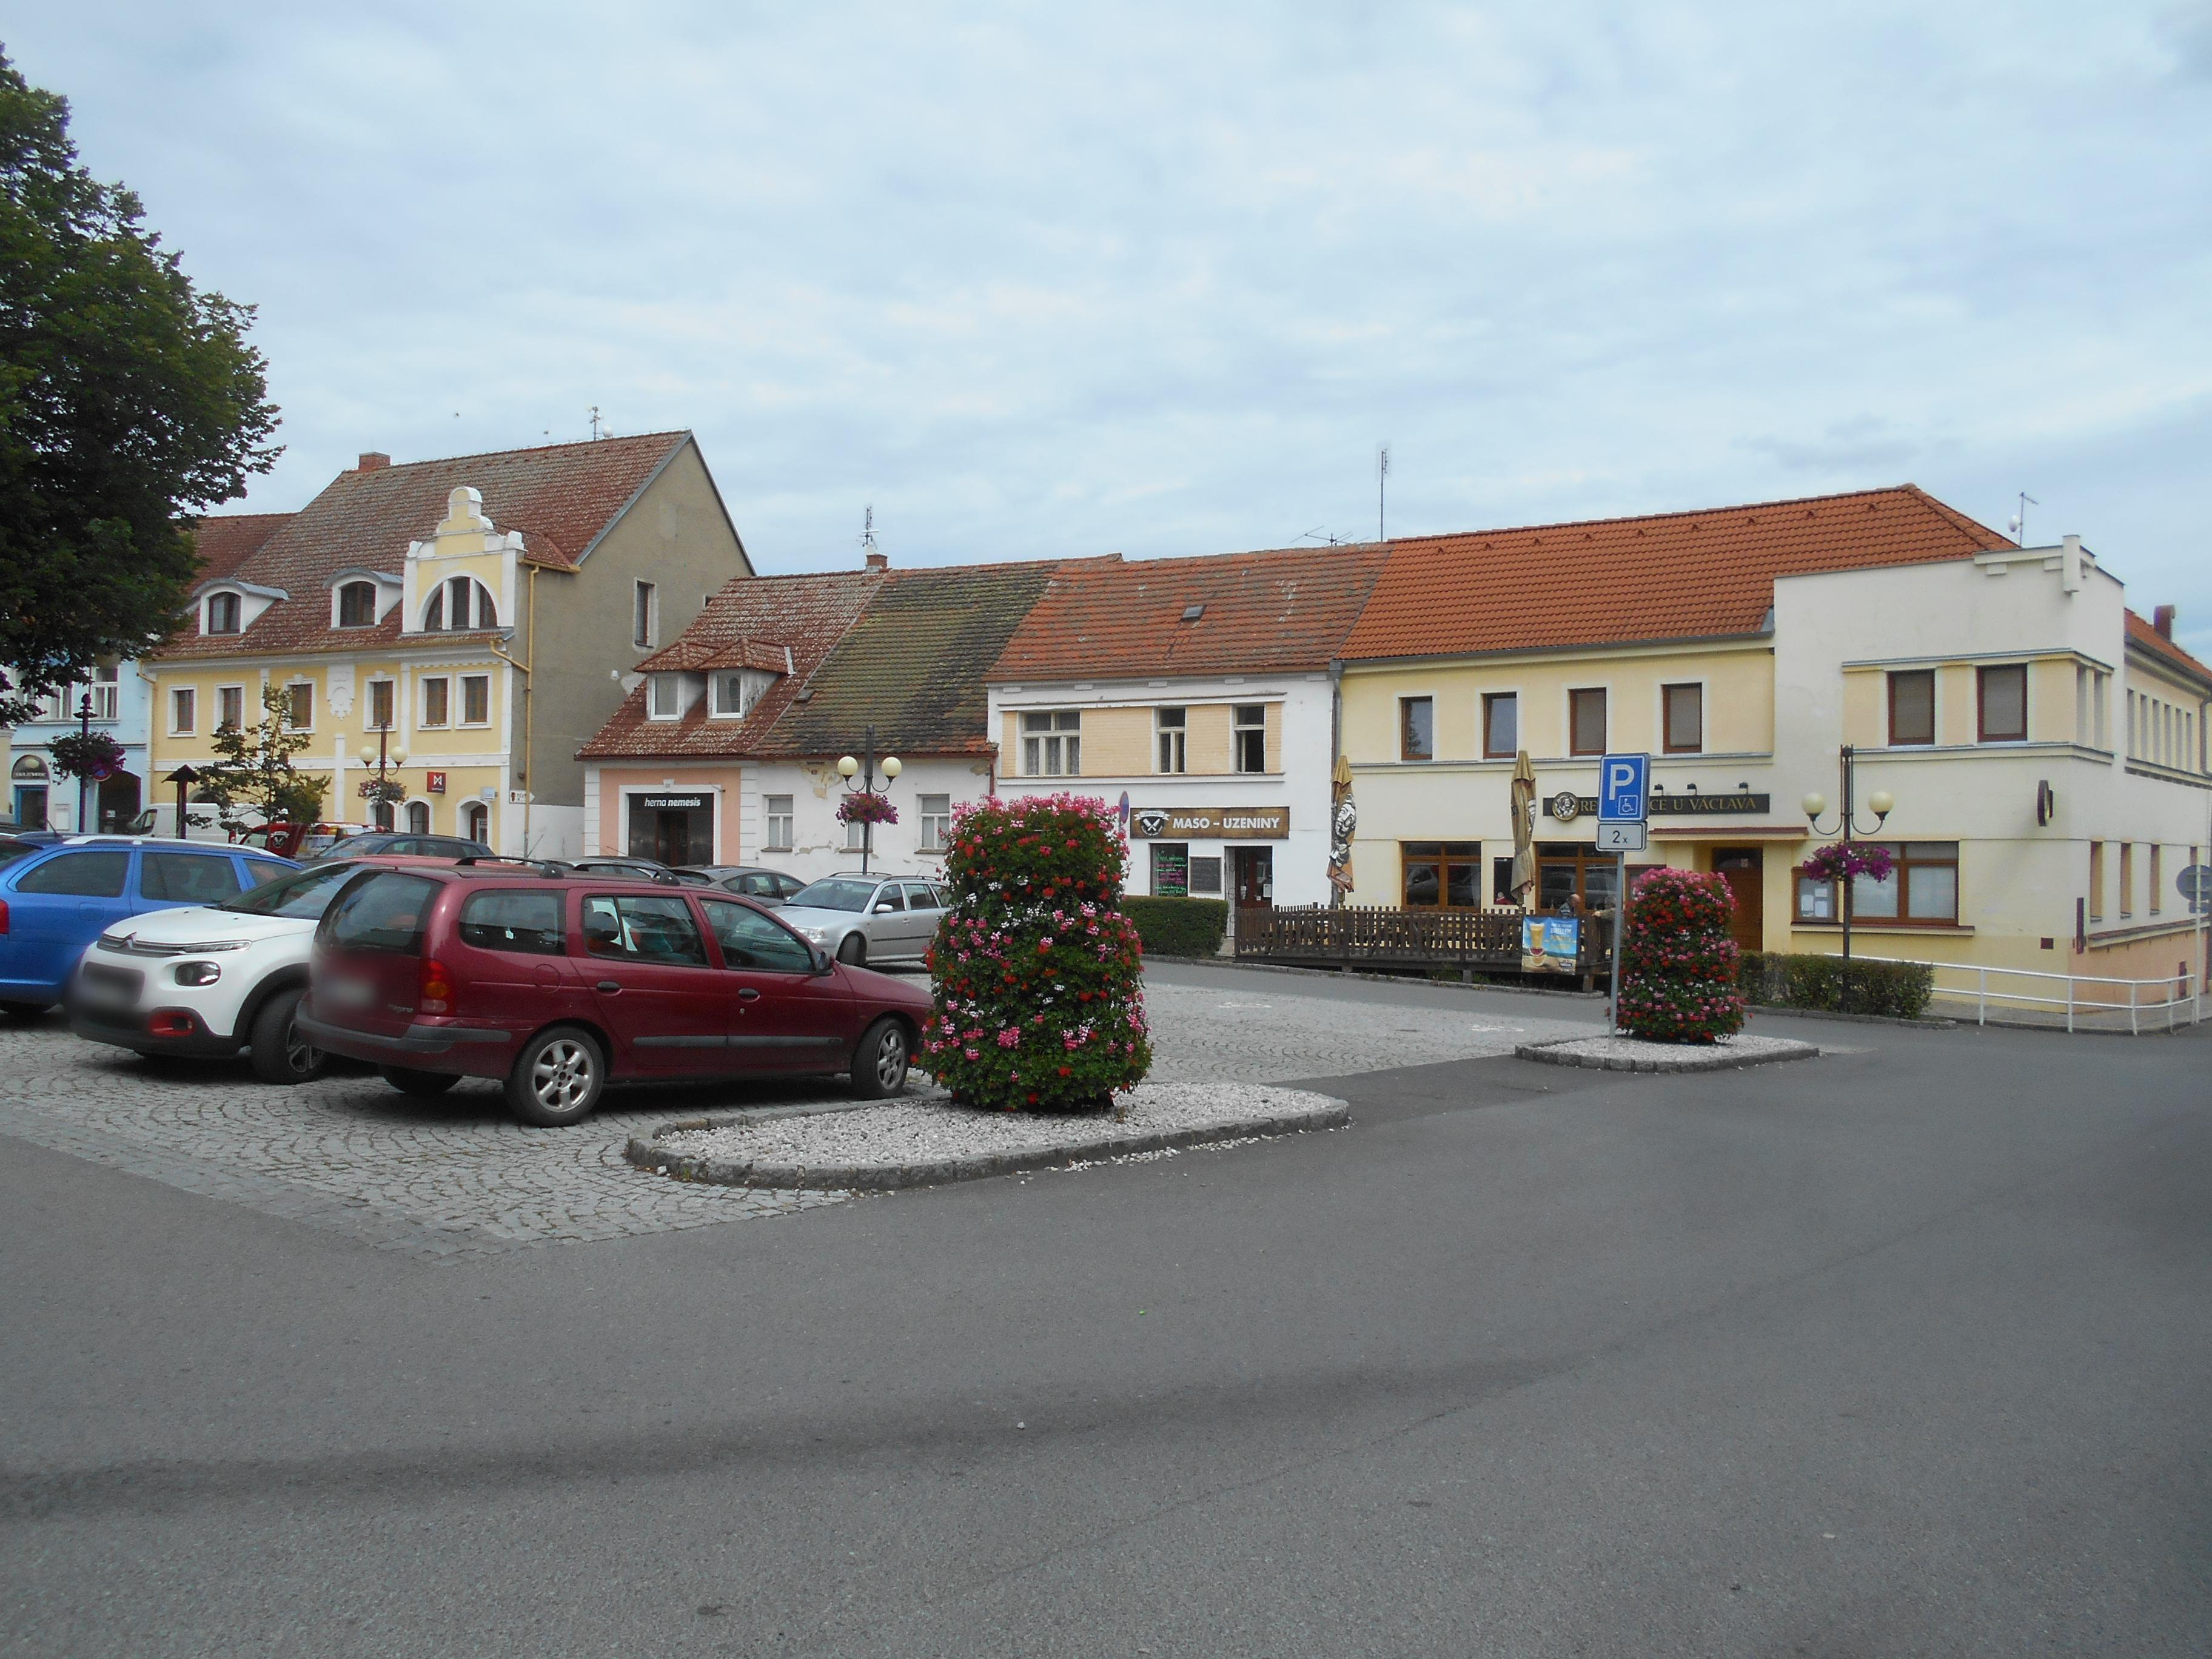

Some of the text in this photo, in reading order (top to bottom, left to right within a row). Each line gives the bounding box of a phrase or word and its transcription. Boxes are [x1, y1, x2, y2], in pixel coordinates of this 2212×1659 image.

[1609, 764, 1635, 800] P
[645, 797, 702, 807] herna nemesis
[1674, 798, 1683, 811] U
[1689, 796, 1757, 811] VÁCLAVA
[1172, 817, 1210, 829] MASO
[1222, 817, 1280, 829] UZENINY
[1612, 830, 1620, 843] 2
